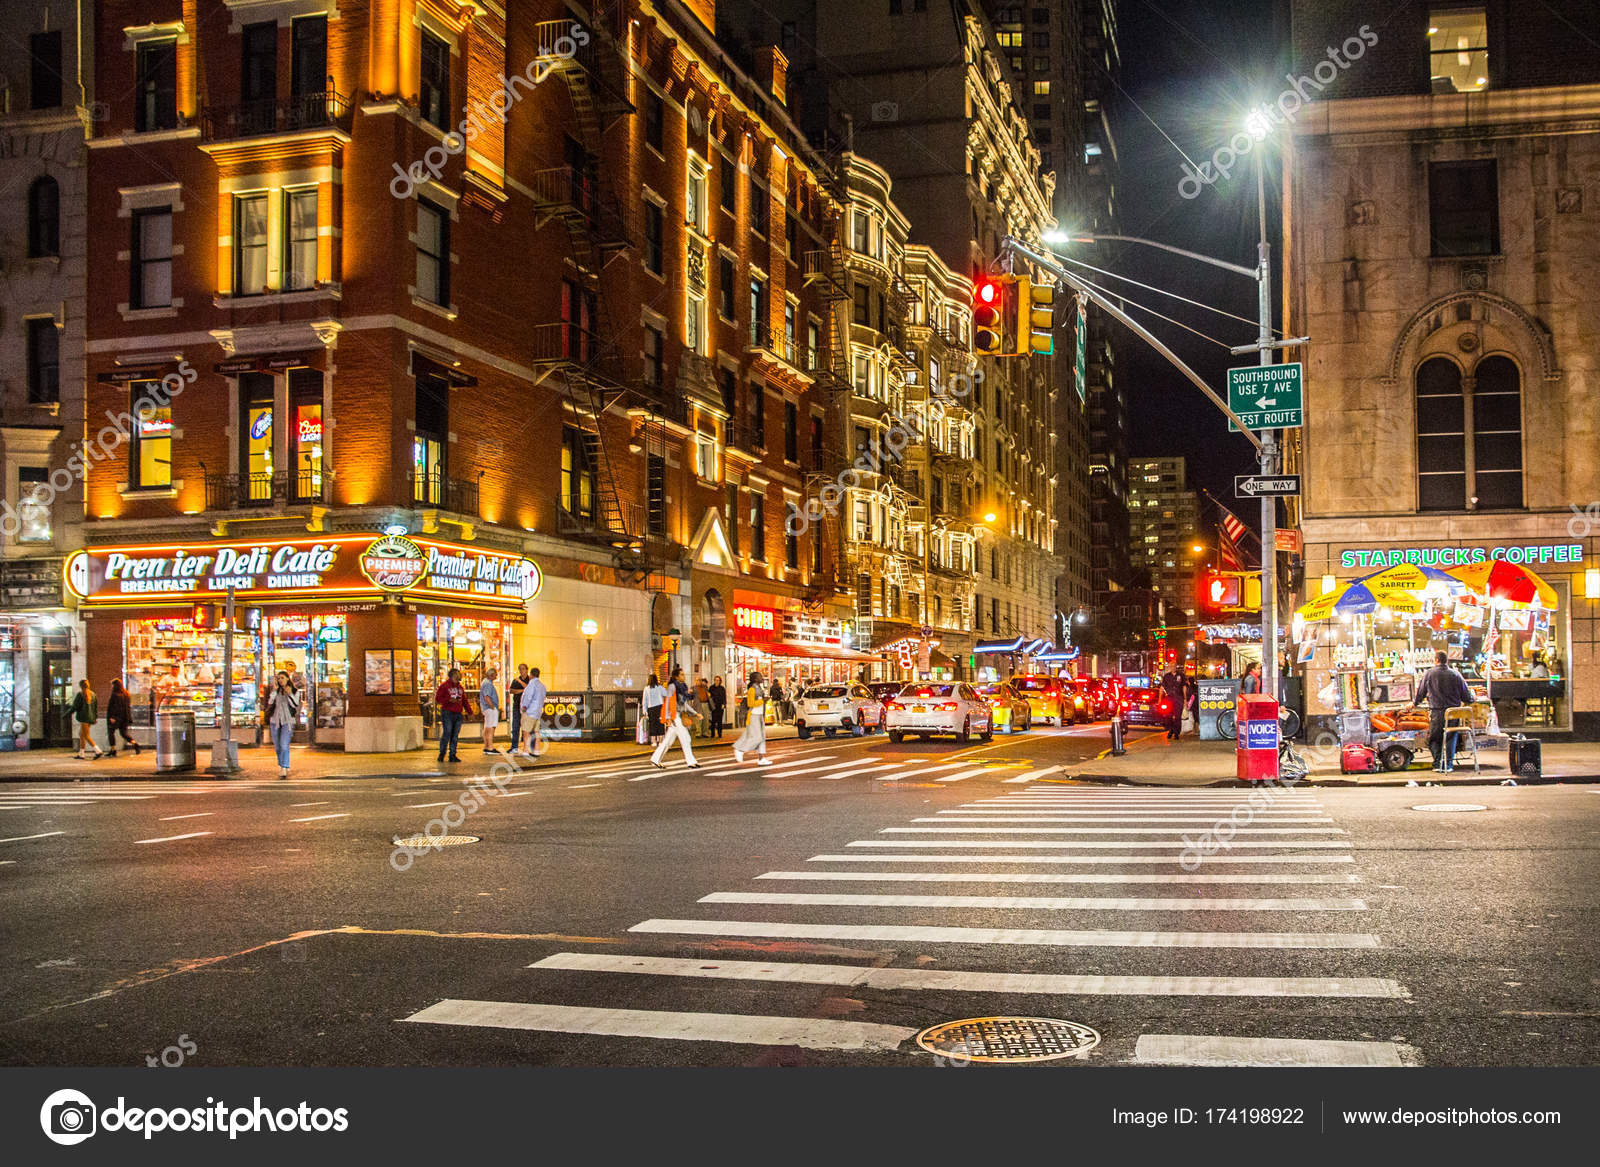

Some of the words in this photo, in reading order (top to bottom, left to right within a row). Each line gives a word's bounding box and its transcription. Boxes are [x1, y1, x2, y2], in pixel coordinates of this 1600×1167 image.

[1233, 369, 1297, 383] SOUTHBOUND
[1238, 384, 1258, 395] USE
[1262, 383, 1268, 393] 7
[1274, 381, 1292, 392] AVE
[1264, 412, 1296, 423] ROUTE
[1245, 482, 1264, 491] ONE
[1272, 481, 1292, 490] WAY
[214, 547, 270, 576] Deli
[272, 544, 340, 573] Café
[428, 547, 476, 578] Premier
[476, 555, 499, 580] Deli
[1341, 547, 1486, 568] STARBUCKS
[1490, 545, 1583, 564] COFFEE
[366, 558, 421, 571] PREMIER
[121, 579, 198, 593] BREAKFAST
[208, 576, 254, 590] LUNCH
[267, 574, 321, 588] DINNER
[431, 576, 470, 591] BREAKFAST
[336, 604, 376, 612] 212-757-4477
[737, 607, 774, 630] CORNER
[1210, 686, 1232, 694] Street
[1250, 724, 1276, 735] VOICE
